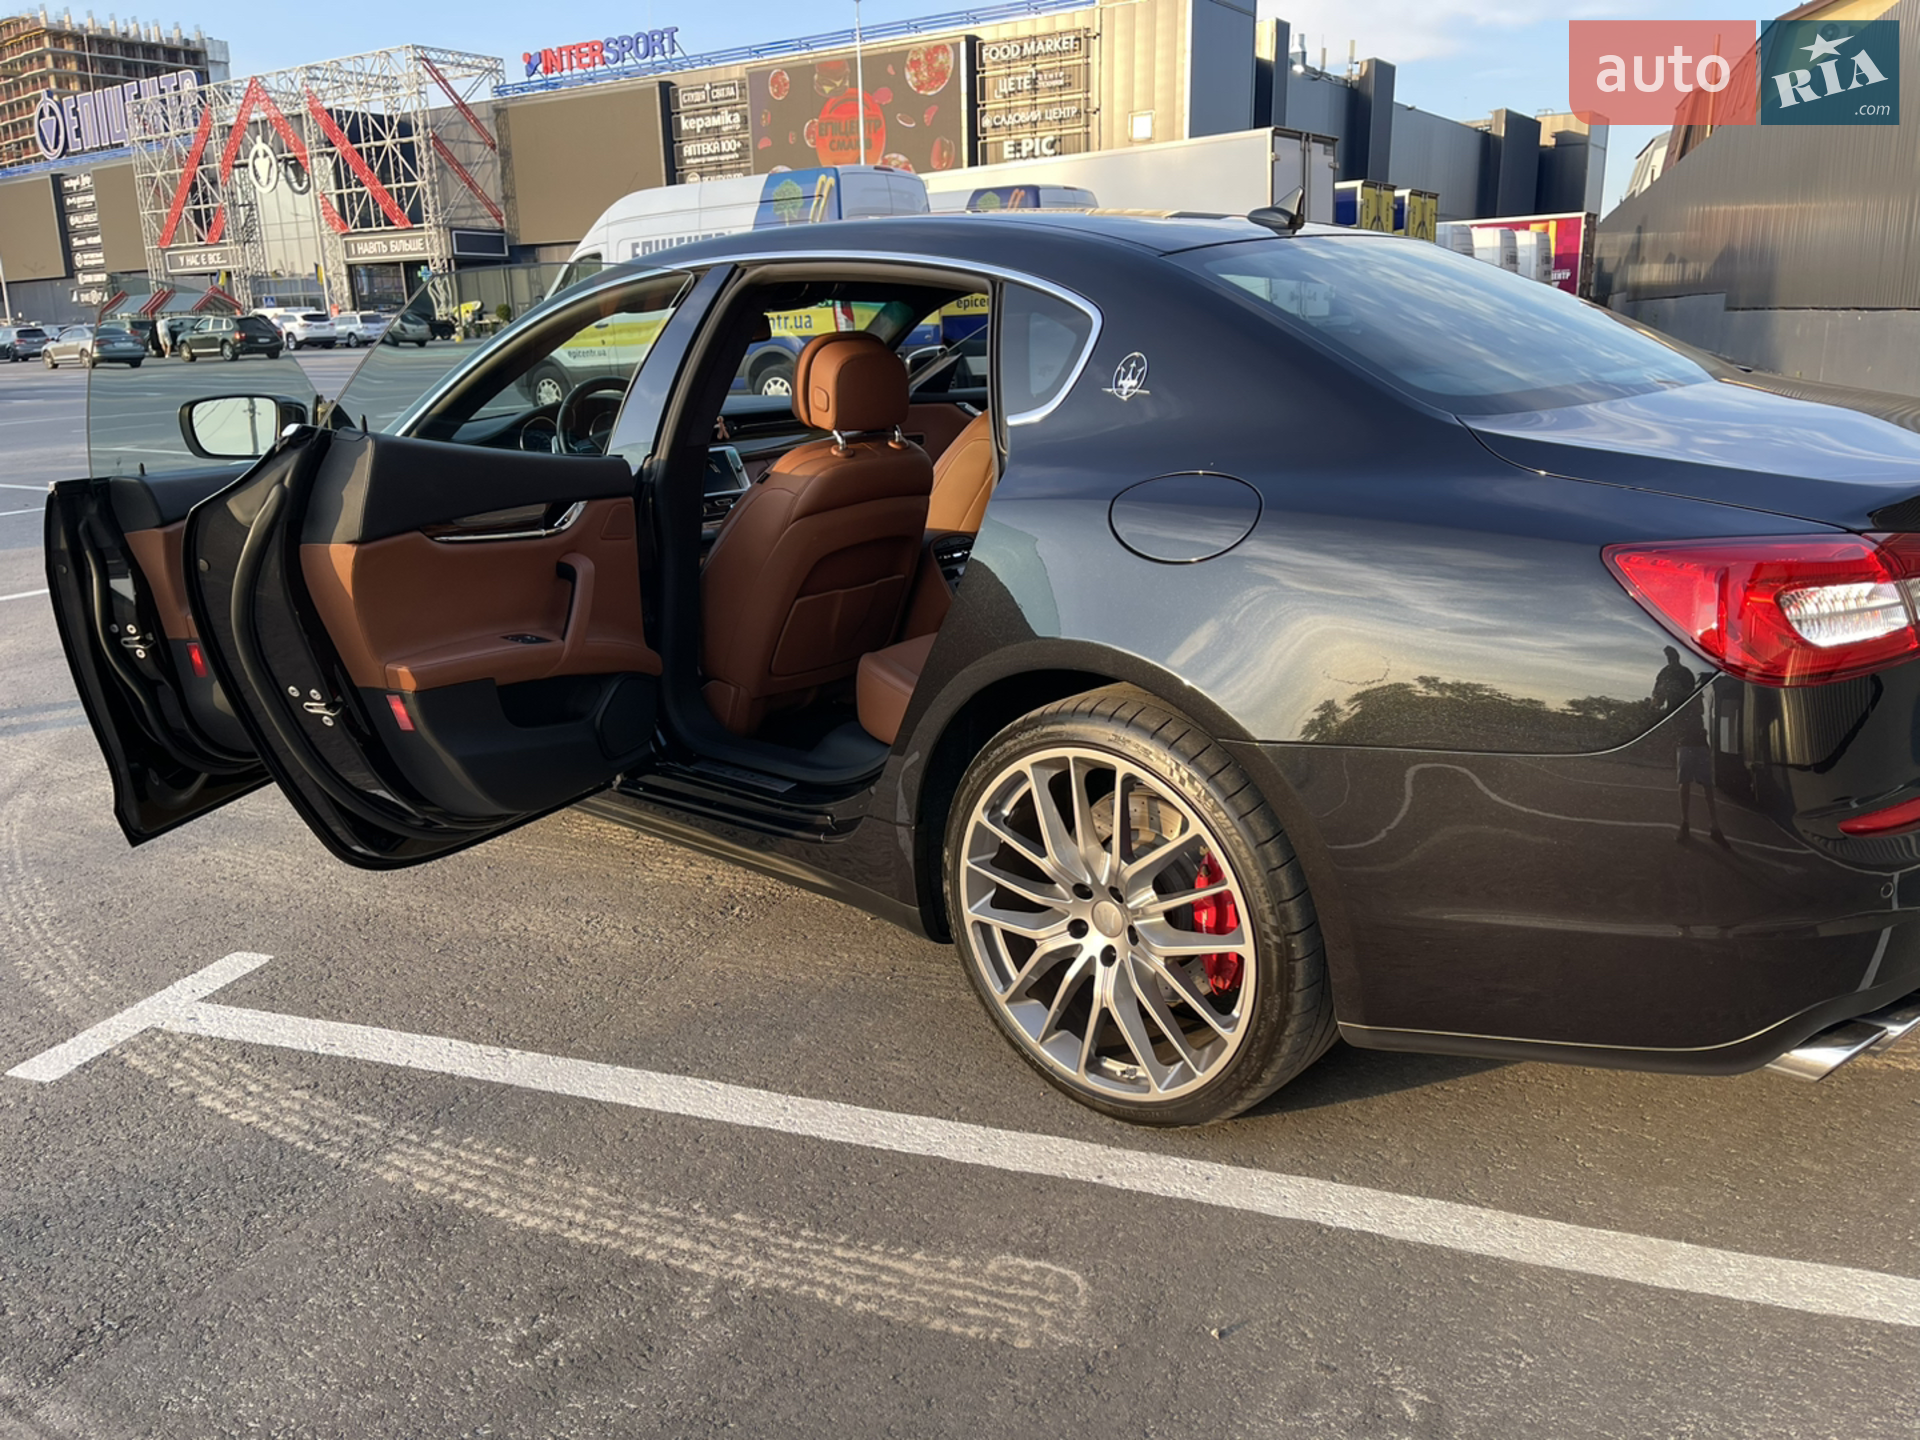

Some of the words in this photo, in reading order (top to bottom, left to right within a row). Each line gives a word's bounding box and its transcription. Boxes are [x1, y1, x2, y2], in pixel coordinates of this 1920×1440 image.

[541, 26, 679, 75] INTERSPORT
[982, 44, 1020, 61] FOOD
[1022, 35, 1076, 56] MARKET
[1044, 106, 1078, 120] ЦЕНТР
[683, 141, 720, 157] АПТЕКА
[1003, 136, 1056, 159] E.PIC
